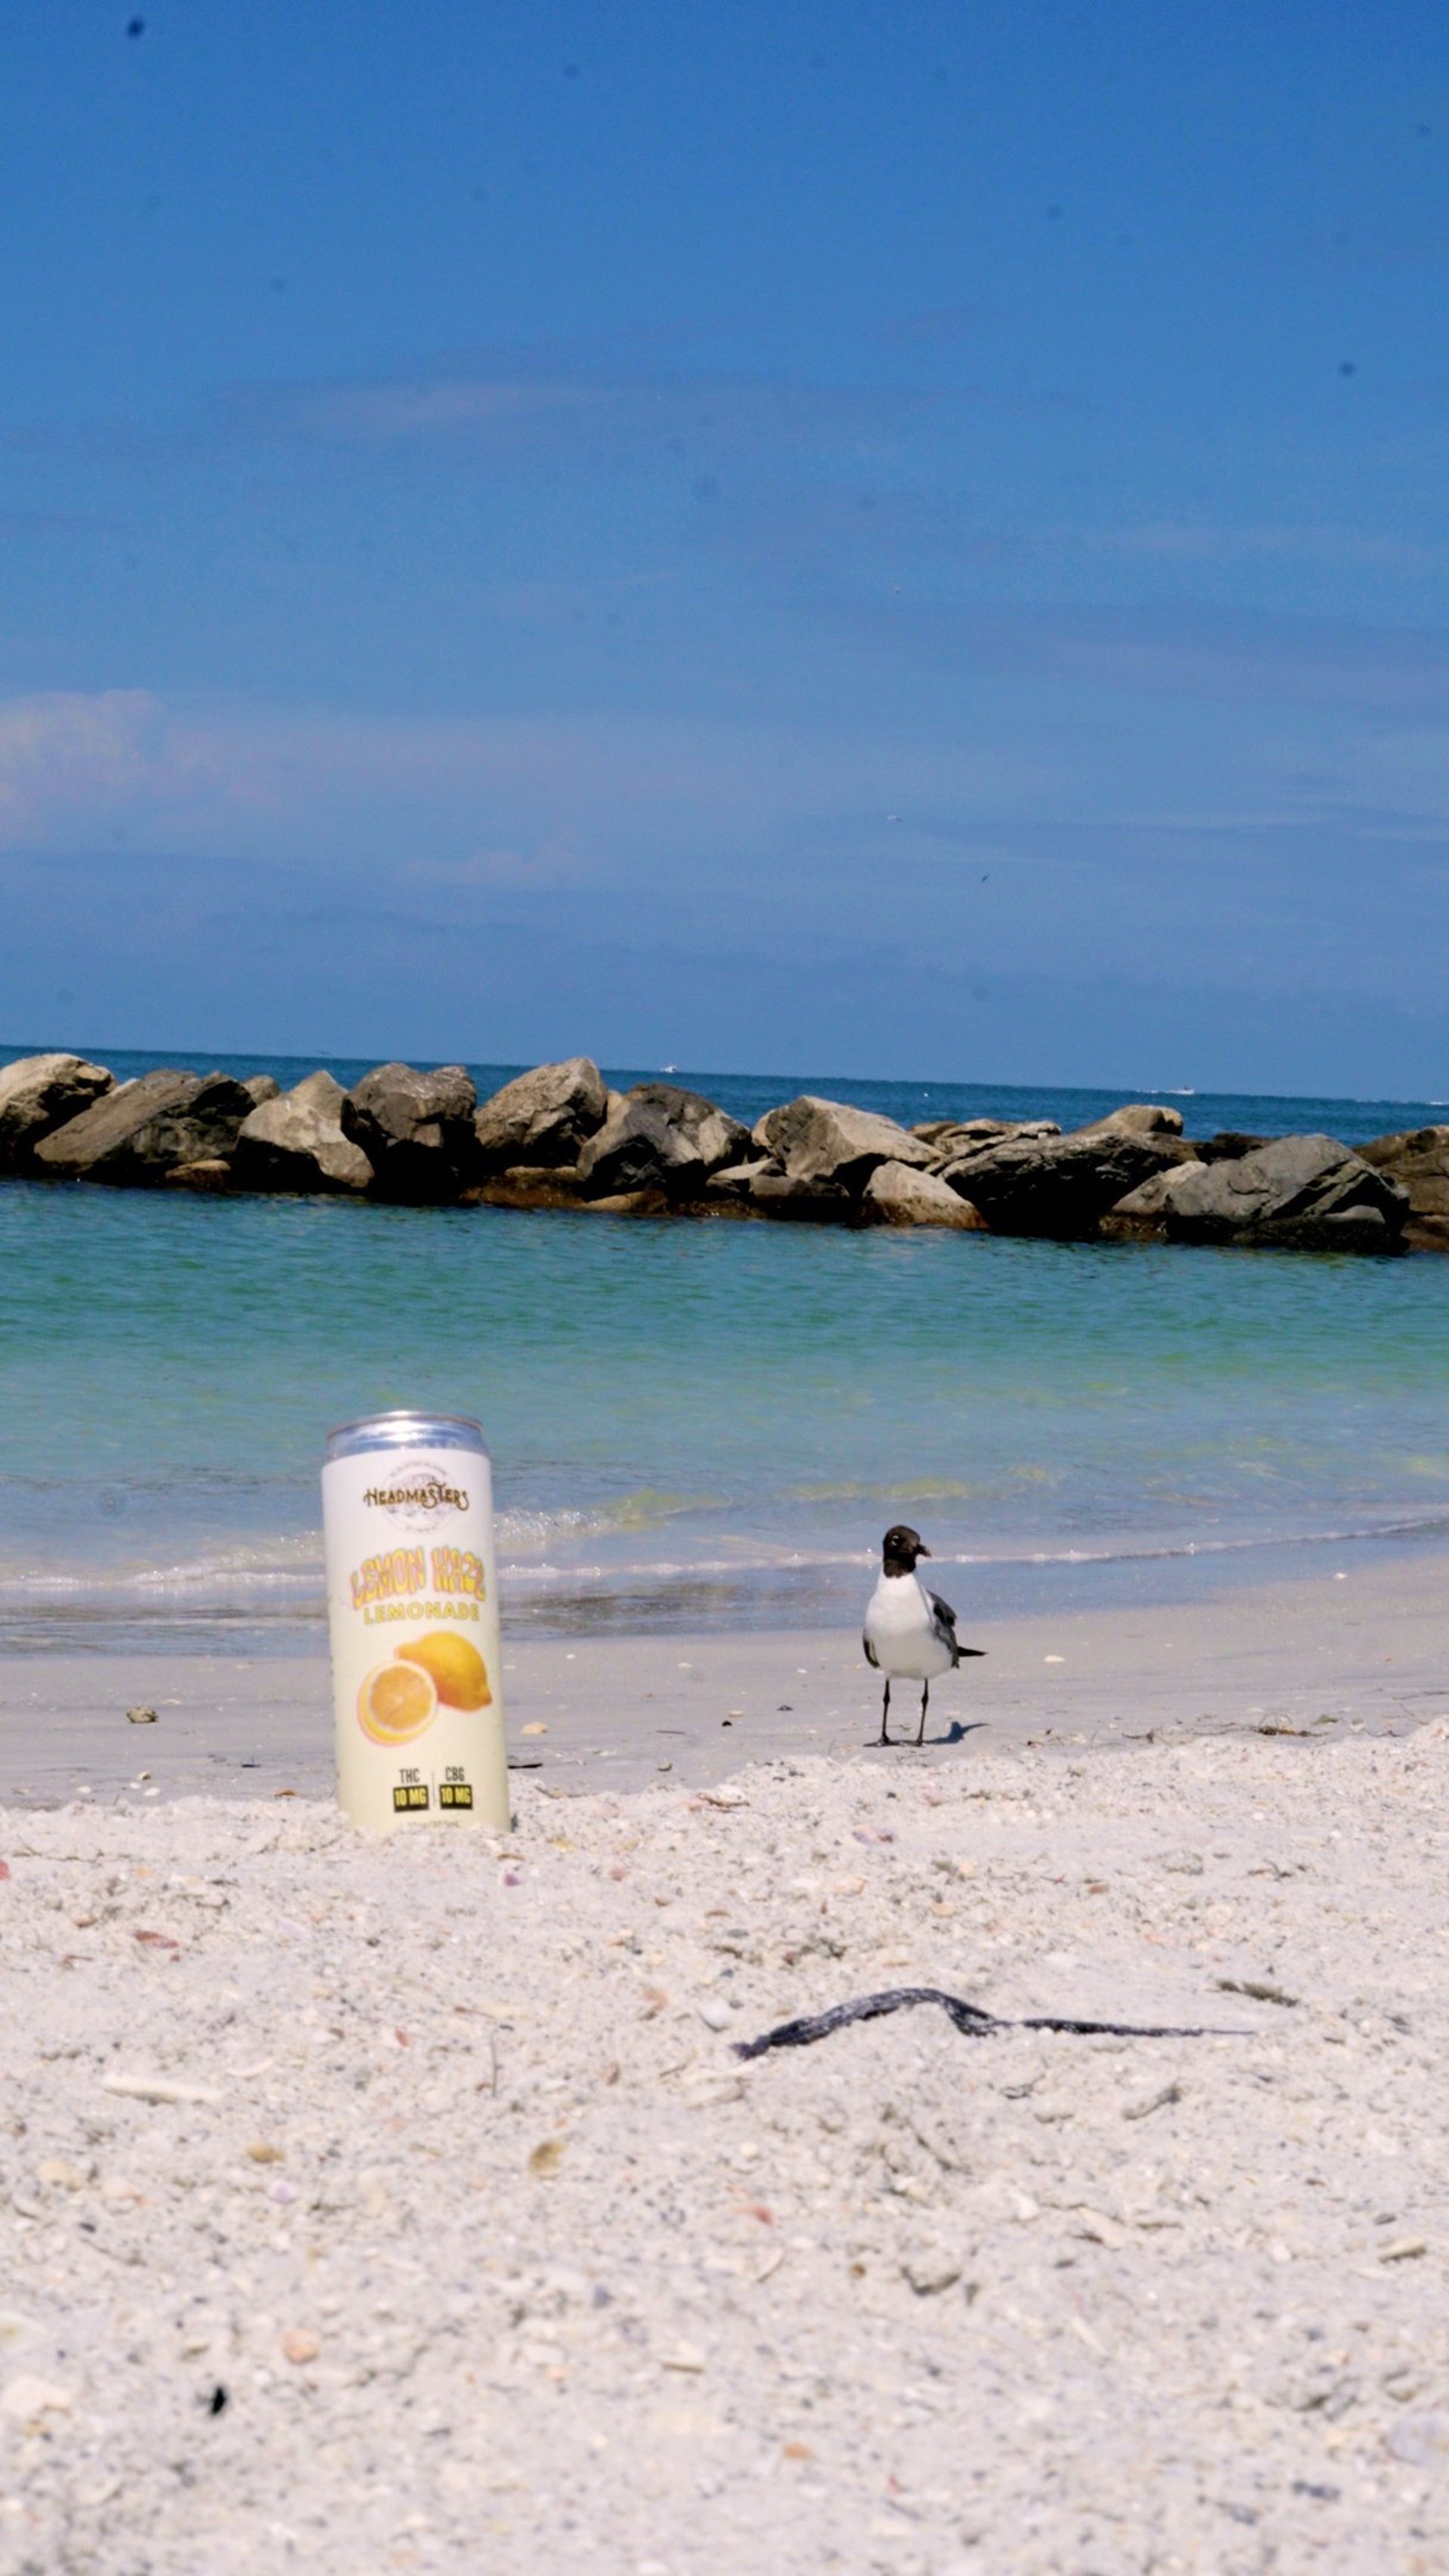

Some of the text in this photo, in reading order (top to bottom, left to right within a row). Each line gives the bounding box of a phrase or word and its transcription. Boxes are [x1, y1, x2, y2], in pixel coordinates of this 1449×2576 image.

[363, 1482, 469, 1511] HEADMASTERS
[350, 1545, 427, 1611] LEMON
[363, 1601, 480, 1625] LEMONADE
[399, 1768, 420, 1784] THC
[445, 1766, 465, 1781] CBG
[395, 1787, 427, 1806] 10 MG
[441, 1787, 471, 1804] 10 MG
